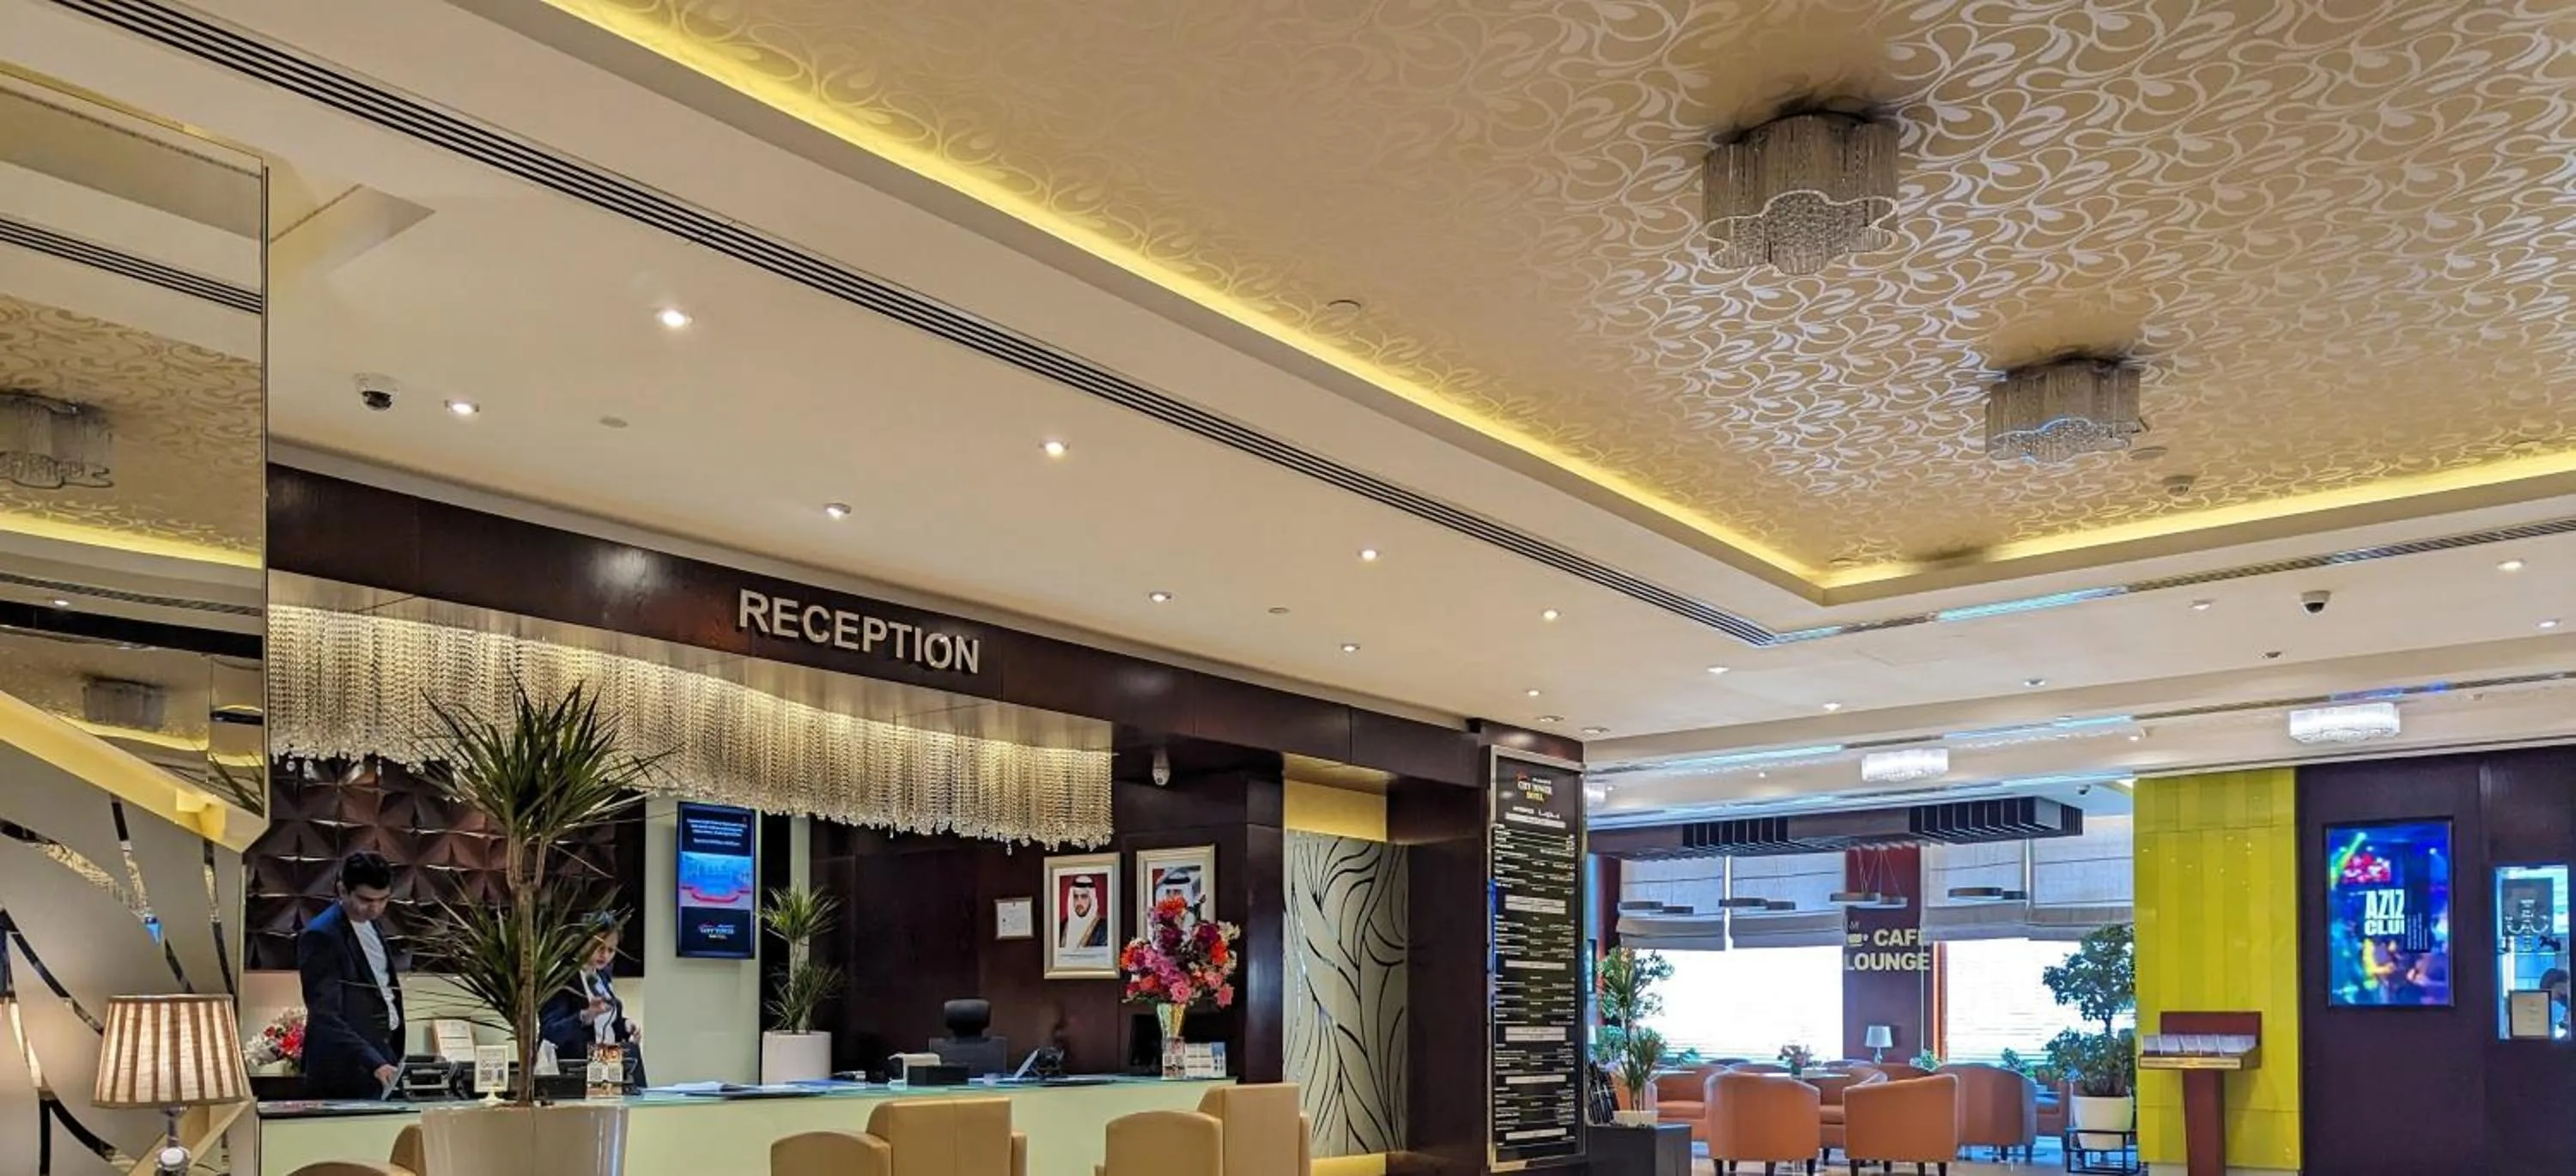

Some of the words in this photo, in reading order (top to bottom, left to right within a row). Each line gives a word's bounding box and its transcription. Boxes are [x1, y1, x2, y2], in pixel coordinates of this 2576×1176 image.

[739, 589, 979, 674] RECEPTION
[2365, 888, 2404, 919] AZIZ
[2364, 919, 2404, 936] CLU
[1844, 952, 1930, 971] LOUNGE
